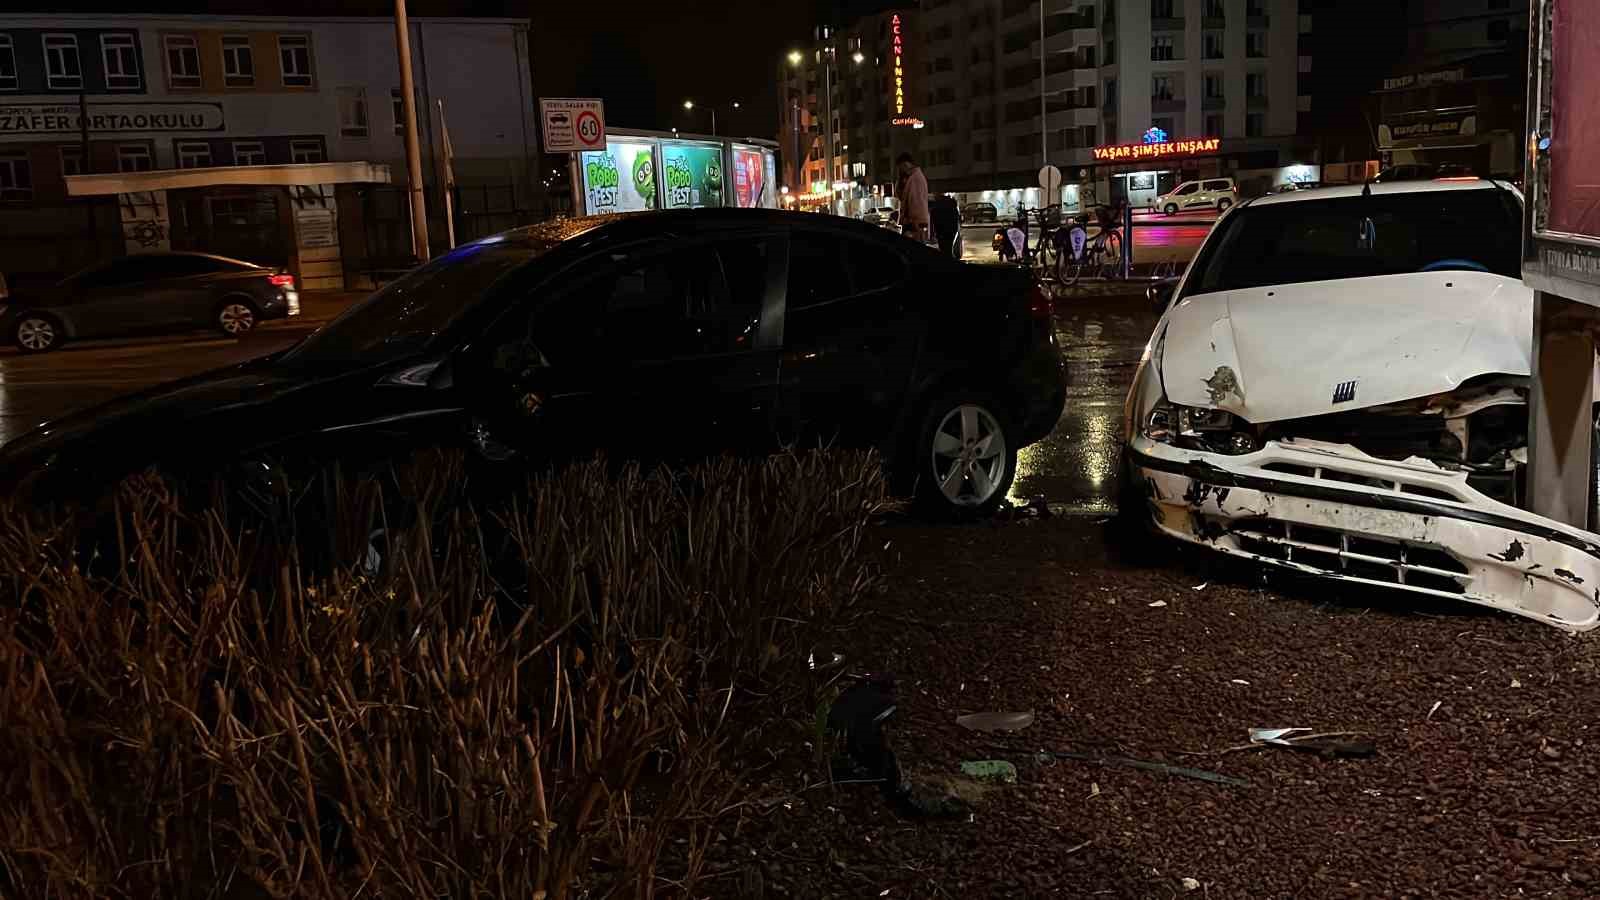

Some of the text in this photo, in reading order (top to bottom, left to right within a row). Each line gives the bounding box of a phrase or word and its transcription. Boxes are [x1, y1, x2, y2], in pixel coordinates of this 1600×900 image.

[892, 14, 903, 54] ACAN
[0, 113, 204, 130] ZAFER ORTAOKULU
[581, 119, 597, 136] 60
[1093, 138, 1220, 160] YAŞAR ŞİMŞEK İNŞAAT
[587, 162, 619, 189] ROBO
[666, 165, 692, 189] ROBO
[595, 188, 619, 208] FEST
[671, 187, 691, 205] FEST
